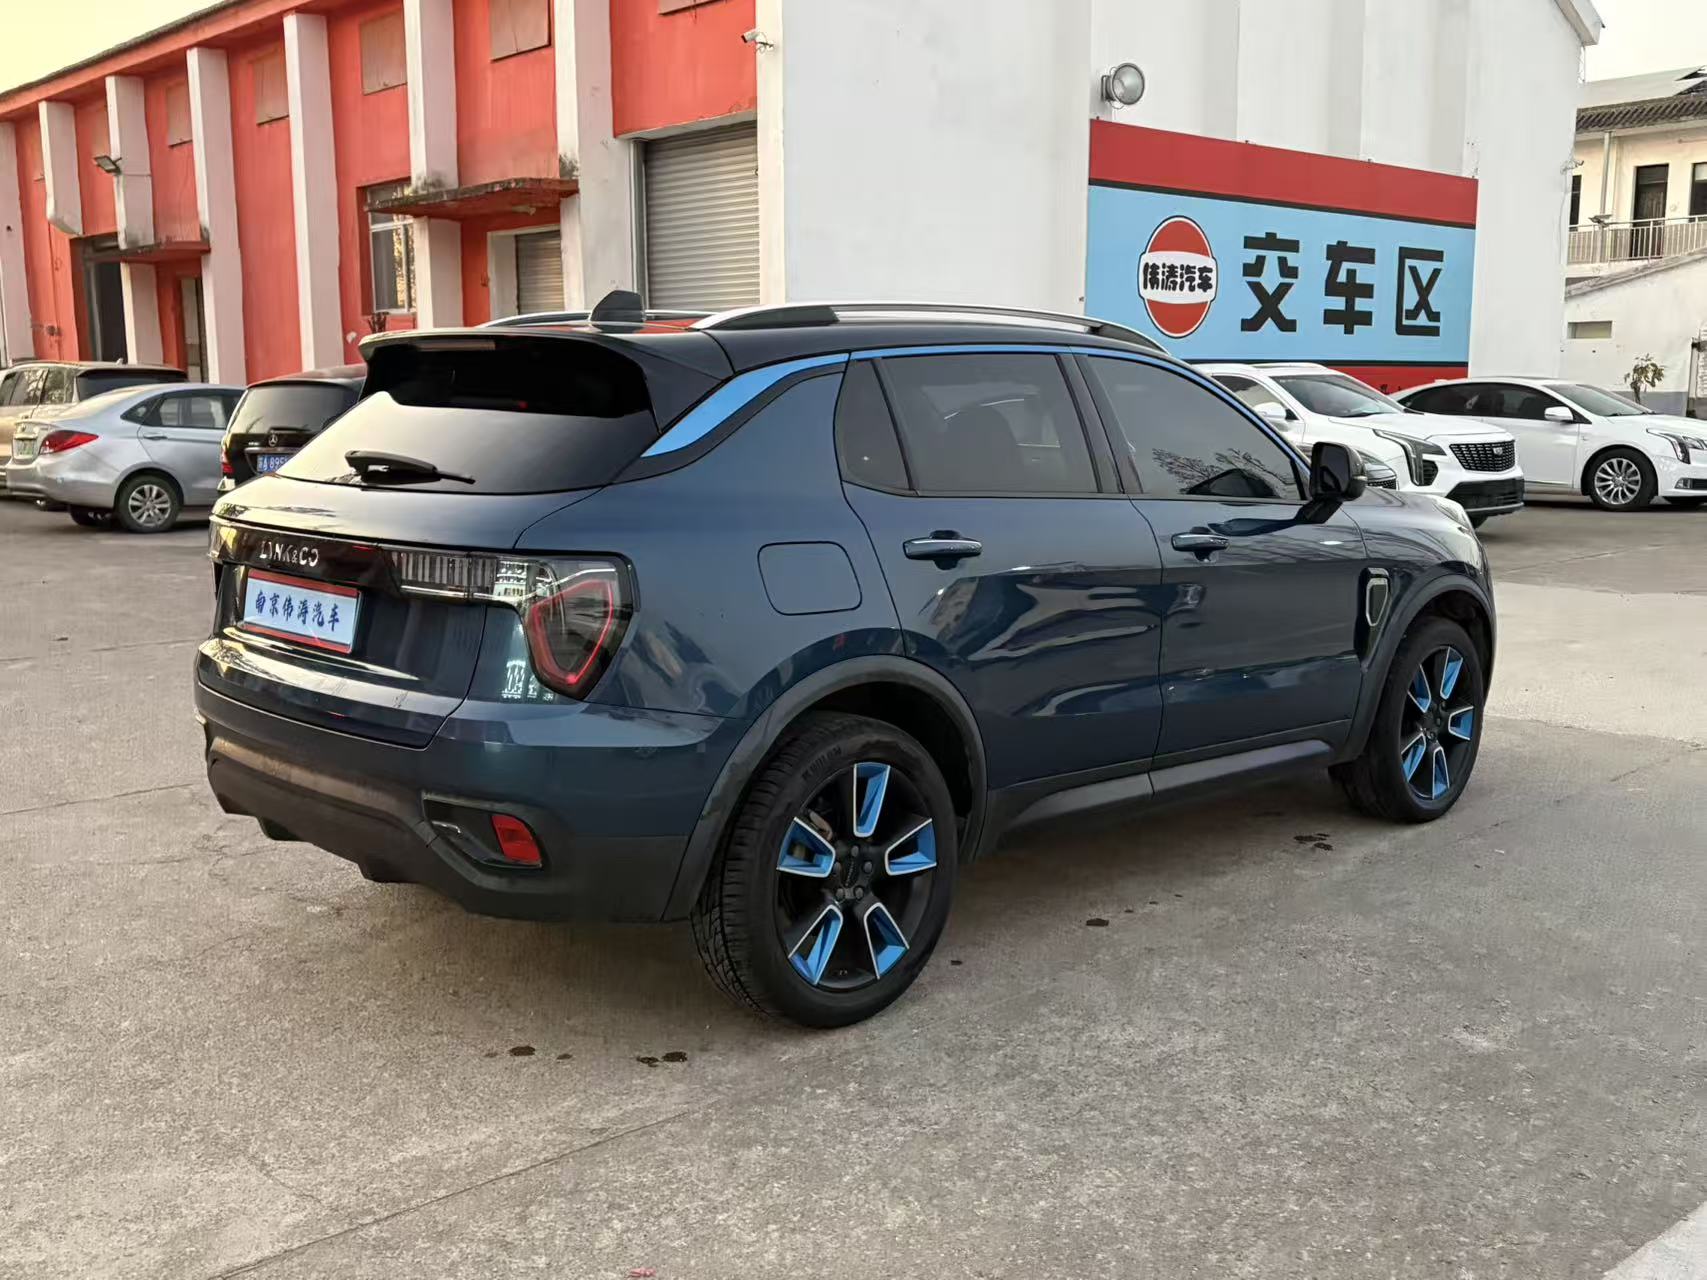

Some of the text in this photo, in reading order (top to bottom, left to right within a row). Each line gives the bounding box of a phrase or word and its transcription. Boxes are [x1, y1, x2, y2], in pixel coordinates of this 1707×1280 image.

[1241, 232, 1444, 336] 交车区
[255, 589, 340, 632] 南京伟涛汽车
